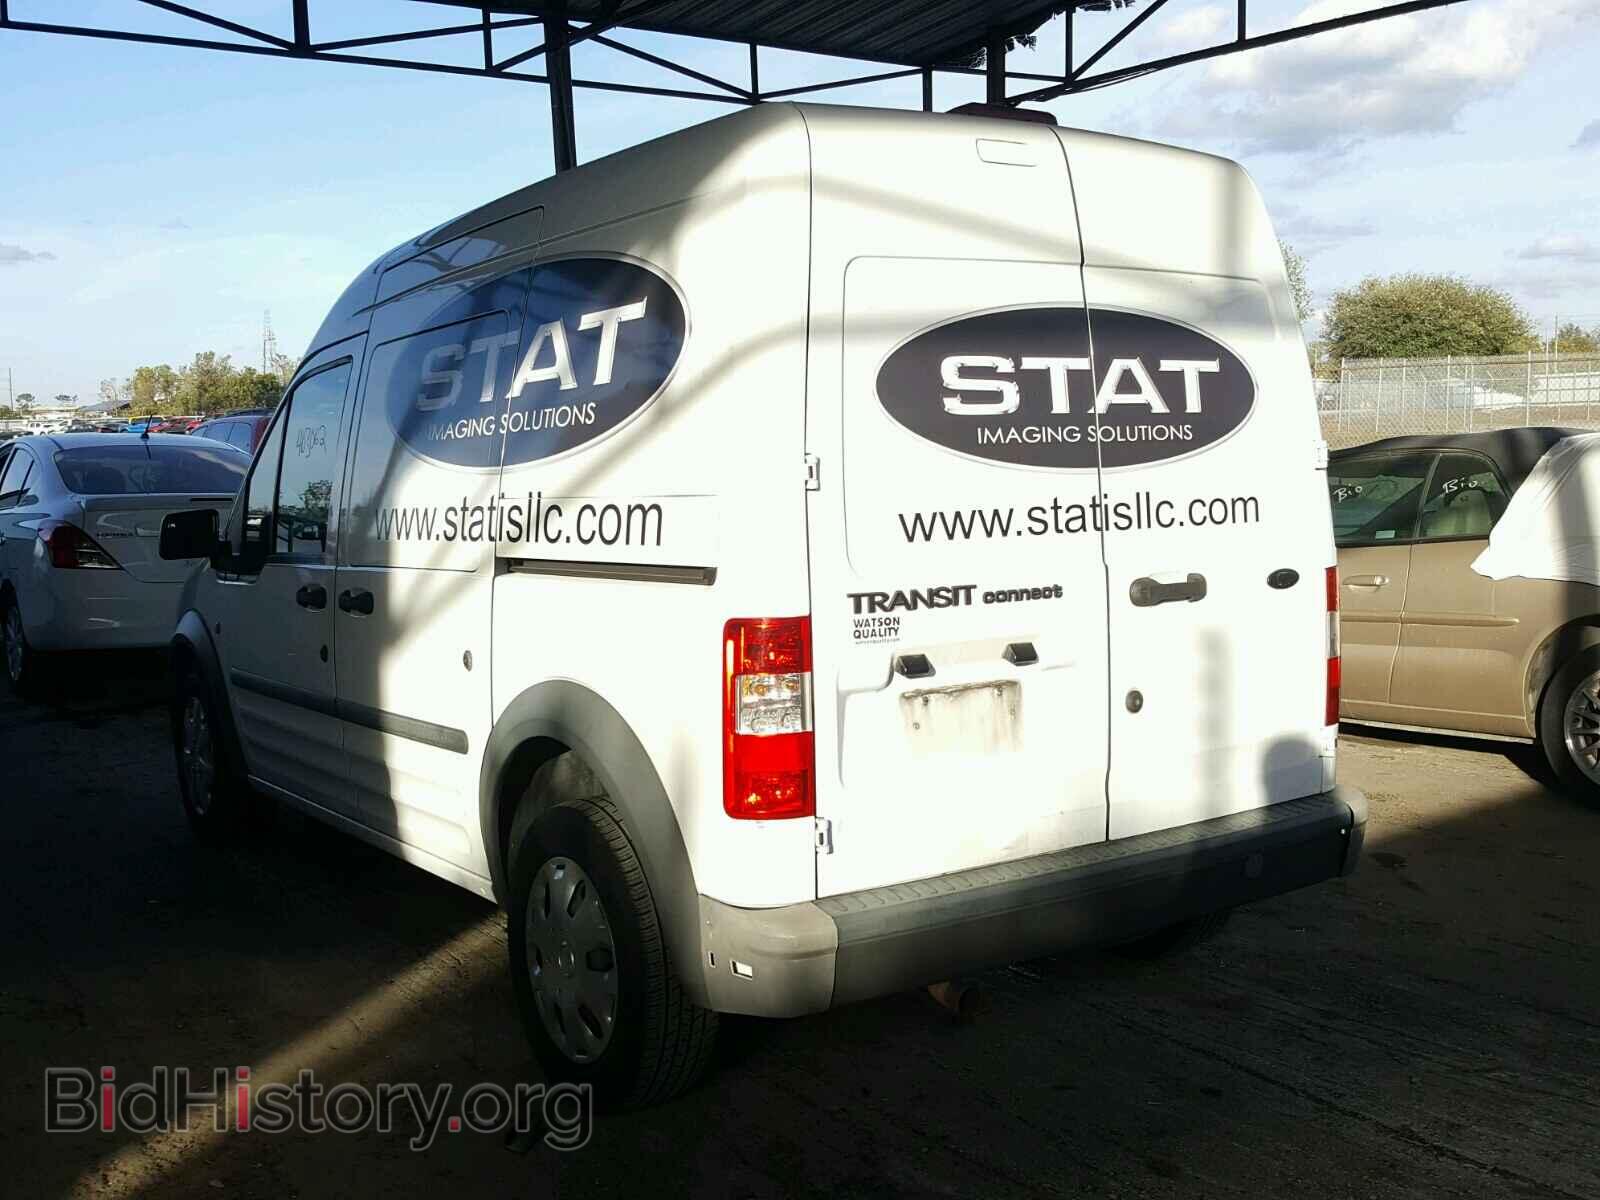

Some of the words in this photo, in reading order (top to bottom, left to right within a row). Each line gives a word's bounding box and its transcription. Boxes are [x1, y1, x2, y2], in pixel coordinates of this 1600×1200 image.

[416, 296, 648, 411] STAT
[939, 354, 1221, 416] STAT
[427, 416, 497, 441] IMAGING
[499, 402, 597, 435] SOLUTIONS
[977, 426, 1081, 444] IMAGING
[1087, 424, 1194, 443] SOLUTIONS
[374, 490, 664, 547] www.statisllc.com
[898, 491, 1261, 544] www.statisllc.com
[846, 584, 978, 615] TRANSIT
[982, 584, 1064, 605] connect
[853, 616, 901, 628] WATSON
[853, 626, 900, 640] QUALITY
